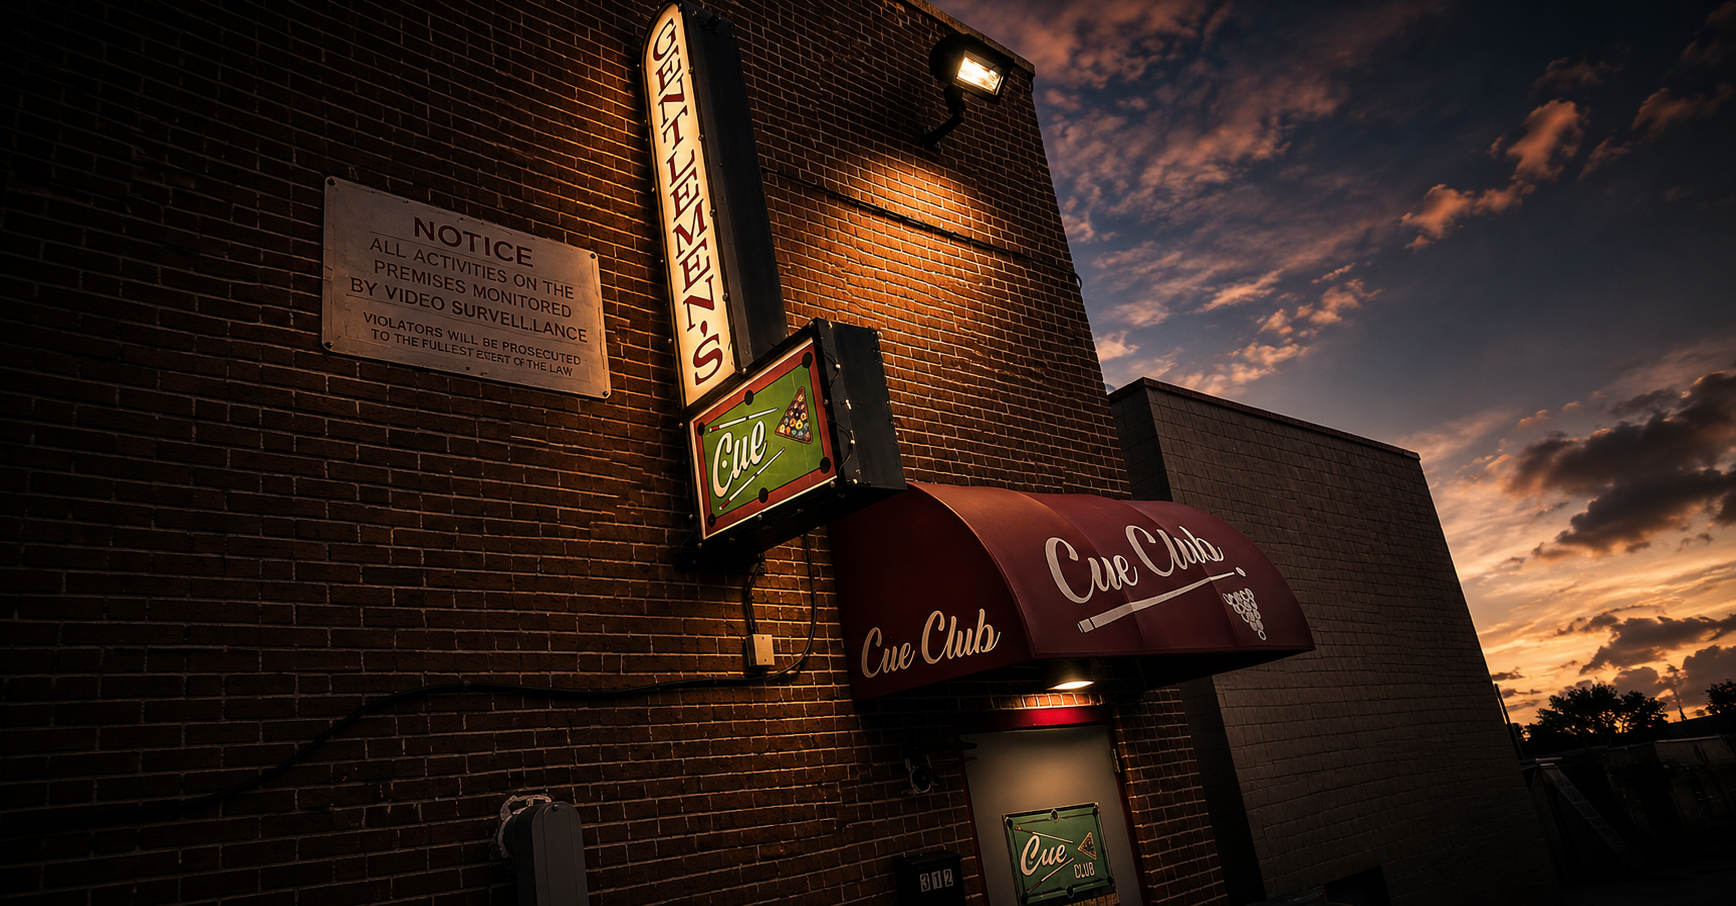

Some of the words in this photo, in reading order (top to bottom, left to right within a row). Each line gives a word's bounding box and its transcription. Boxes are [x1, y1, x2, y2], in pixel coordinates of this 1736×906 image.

[652, 18, 724, 387] GENTLEMEN'S
[369, 238, 407, 259] ALL
[413, 248, 507, 284] ACTIVITIES
[513, 273, 538, 292] ON
[543, 280, 575, 300] THE
[413, 216, 534, 268] NOTICE
[350, 277, 378, 297] BY
[384, 284, 446, 312] VIDEO
[374, 259, 466, 294] PREMISES
[473, 283, 572, 319] MONITORED
[363, 312, 443, 338] VIOLATORS
[447, 330, 479, 346] WILL
[483, 337, 498, 349] BE
[502, 341, 582, 366] PROSECUTED
[370, 328, 390, 341] TO
[393, 333, 420, 347] THE
[422, 338, 475, 357] FULLEST
[527, 359, 547, 371] THE
[550, 364, 573, 376] LAW
[712, 420, 768, 498] Cue
[1045, 536, 1139, 605] Cue
[1124, 524, 1224, 578] Club
[861, 626, 916, 679] Cue
[920, 608, 1002, 665] Club
[919, 868, 954, 893] 312
[1020, 834, 1069, 877] Cue
[1073, 861, 1096, 880] CLUB
